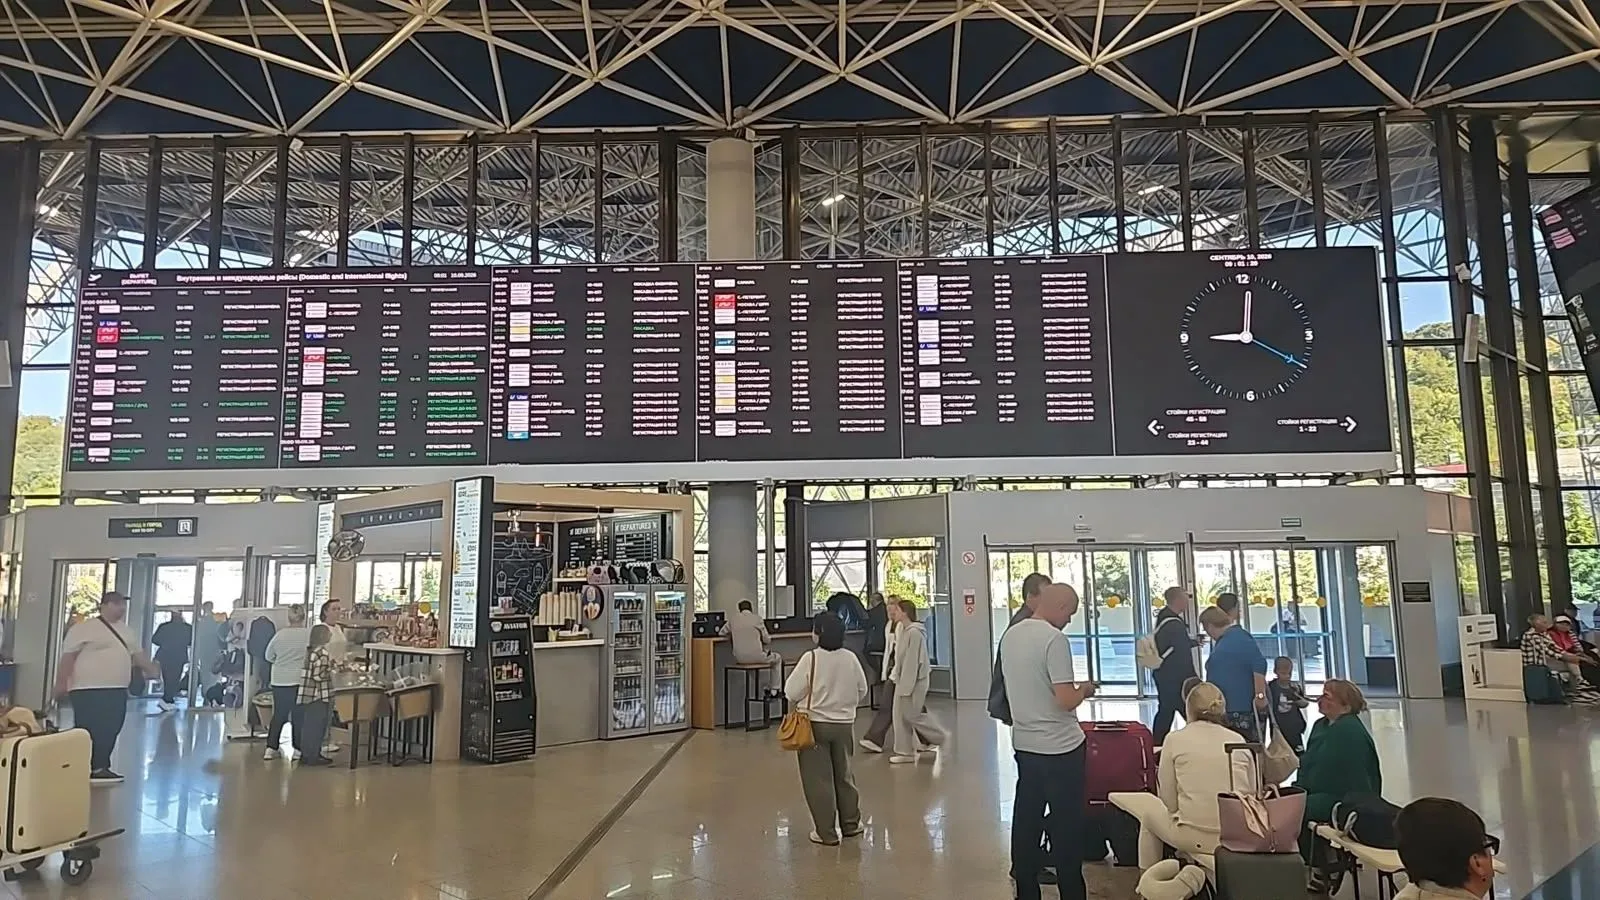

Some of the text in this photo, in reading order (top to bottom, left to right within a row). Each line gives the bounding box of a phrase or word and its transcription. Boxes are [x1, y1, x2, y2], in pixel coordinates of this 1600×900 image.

[276, 273, 298, 282] рейсы
[298, 273, 331, 282] (Domestic
[1235, 273, 1250, 284] 12
[1180, 332, 1189, 344] 9
[1304, 330, 1314, 341] 3
[1246, 390, 1255, 402] 6
[620, 522, 652, 532] DEPARTURES
[503, 622, 528, 630] AVIATOR
